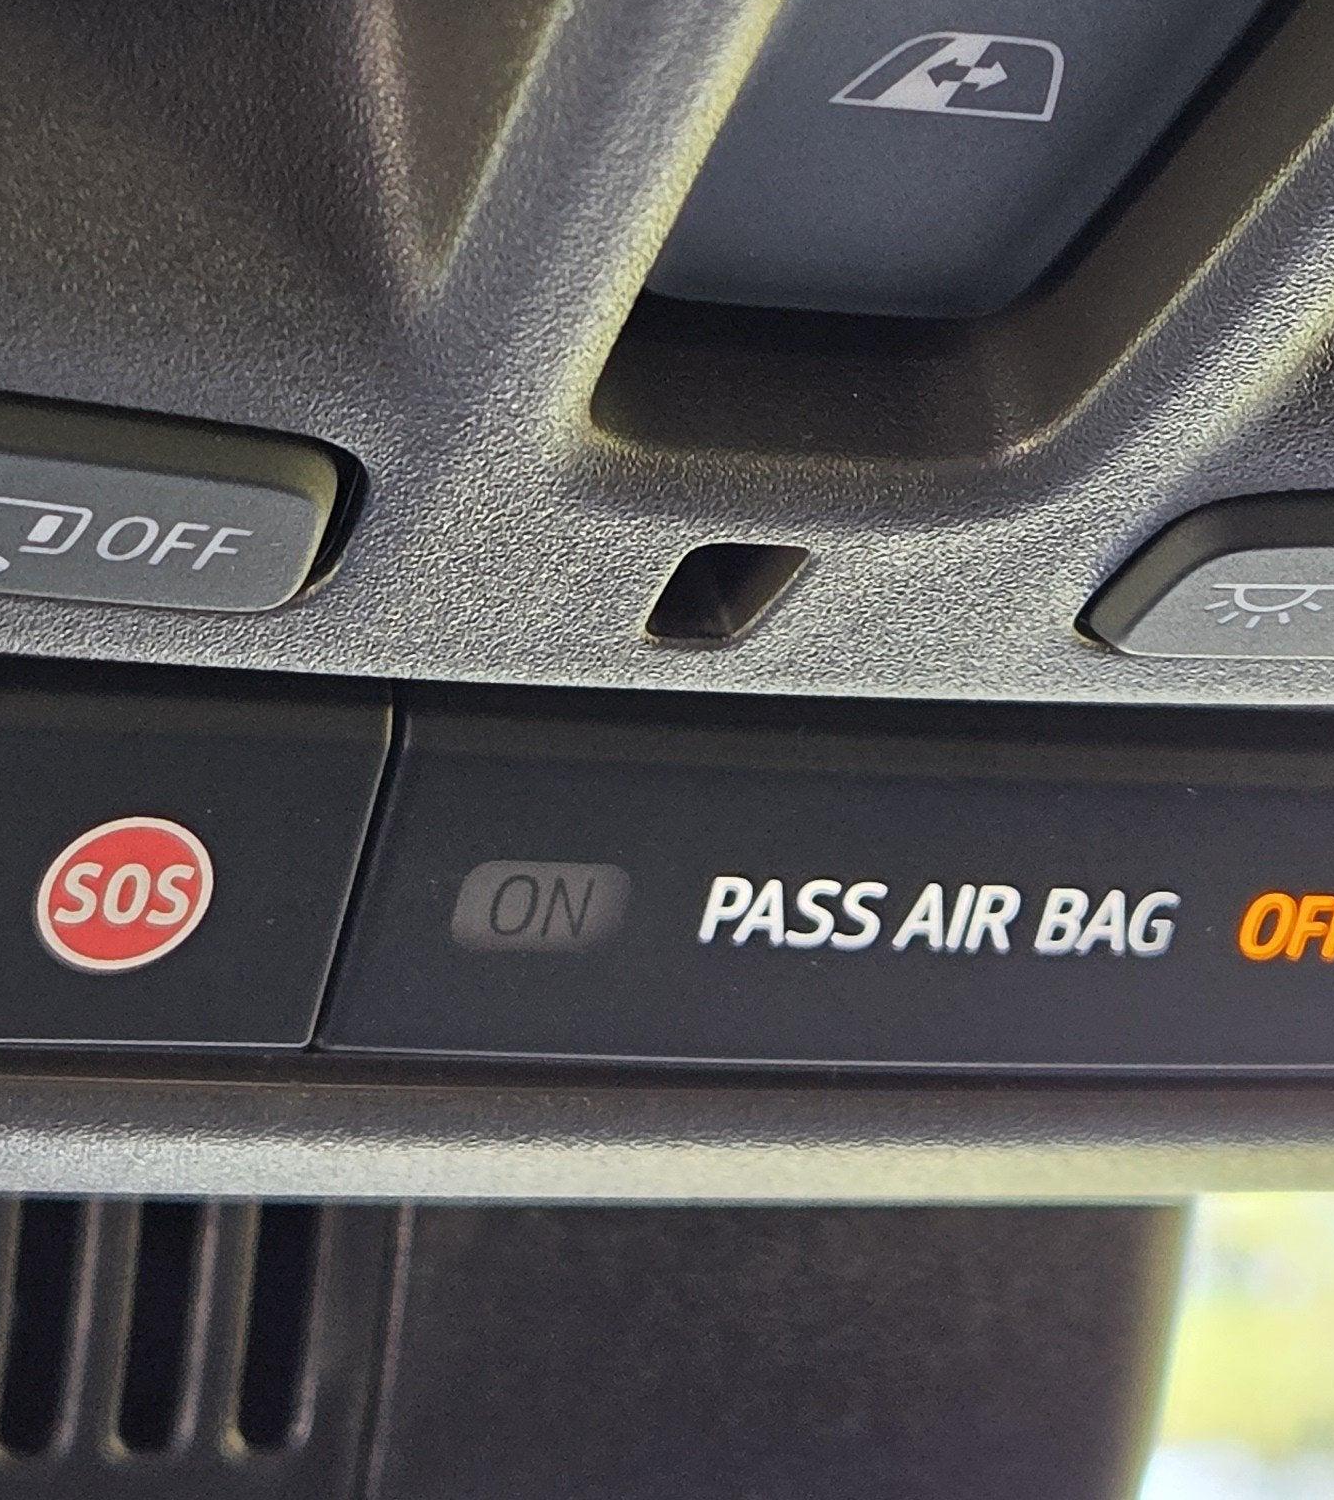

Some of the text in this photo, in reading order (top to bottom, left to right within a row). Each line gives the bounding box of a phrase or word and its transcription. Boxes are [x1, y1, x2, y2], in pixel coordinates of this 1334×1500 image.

[96, 515, 254, 571] OFF
[53, 861, 196, 926] SOS
[488, 873, 597, 939] ON
[698, 876, 889, 950] PASS
[891, 882, 1022, 954] AIR
[1033, 887, 1181, 957] BAG
